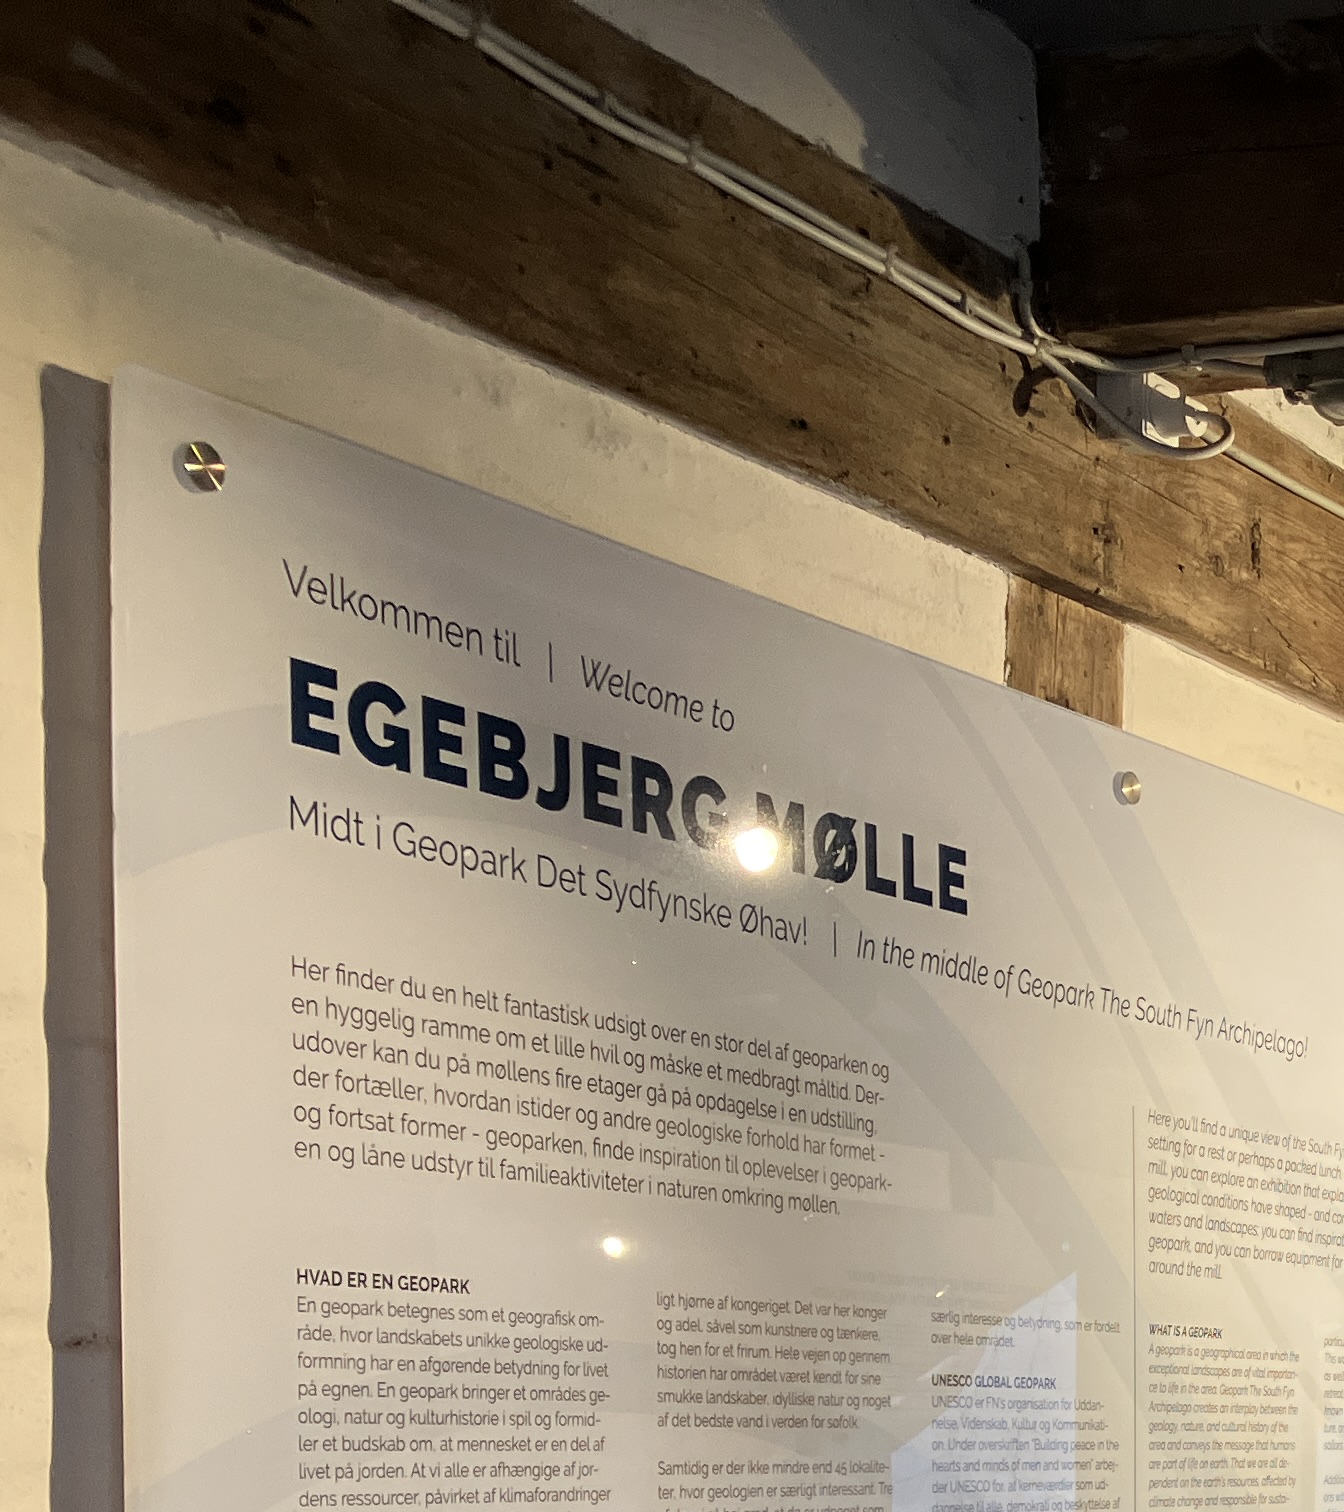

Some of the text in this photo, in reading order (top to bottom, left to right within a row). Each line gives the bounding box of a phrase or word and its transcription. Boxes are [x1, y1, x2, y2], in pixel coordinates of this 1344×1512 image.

[282, 558, 521, 668] Velkommen til
[580, 655, 735, 733] Welcome to
[289, 657, 729, 849] EGEBJERG
[289, 795, 366, 847] Midt
[392, 821, 528, 884] Geopark
[537, 853, 588, 897] Det
[595, 868, 732, 929] Sydfynske
[739, 903, 807, 946] Øhav!
[291, 955, 890, 1084] Her finder du en helt fantastisk udsigt over en stor del af geoparken og
[856, 930, 1308, 1063] In the middle of Geopark The South Fyn Archipelago!
[291, 996, 319, 1017] en
[325, 995, 415, 1039] hyggelig
[421, 1018, 491, 1045] ramme
[495, 1029, 526, 1050] om
[531, 1032, 551, 1055] et
[554, 1033, 586, 1060] lille
[590, 1039, 620, 1066] hvil
[623, 1050, 645, 1075] og
[649, 1052, 703, 1078] måske
[706, 1062, 723, 1082] et
[726, 1067, 801, 1098] medbragt
[855, 1083, 885, 1105] Der-
[292, 1030, 368, 1059] udover
[373, 1039, 409, 1066] kan
[414, 1047, 441, 1071] du
[446, 1053, 471, 1077] på
[476, 1059, 551, 1087] møllens
[555, 1066, 583, 1091] fire
[586, 1074, 643, 1103] etager
[646, 1083, 667, 1108] gå
[671, 1086, 692, 1109] på
[695, 1092, 778, 1120] opdagelse
[788, 1106, 807, 1124] en
[292, 1064, 330, 1089] der
[433, 1082, 511, 1114] hvordan
[516, 1096, 571, 1122] istider
[575, 1107, 598, 1132] og
[602, 1110, 652, 1133] andre
[655, 1117, 743, 1147] geologiske
[746, 1126, 800, 1152] forhold
[803, 1134, 826, 1155] har
[829, 1137, 876, 1162] formet
[293, 1104, 322, 1131] og
[328, 1102, 395, 1134] fortsat
[400, 1111, 467, 1142] former
[592, 1136, 635, 1162] finde
[639, 1148, 721, 1172] inspiration
[725, 1154, 739, 1175] til
[742, 1158, 819, 1184] oplevelser
[830, 1171, 892, 1193] geopark-
[293, 1140, 321, 1160] en
[327, 1144, 355, 1170] og
[361, 1142, 406, 1170] låne
[411, 1150, 474, 1181] udstyr
[477, 1157, 496, 1179] til
[499, 1158, 645, 1194] familieaktiviteter
[656, 1179, 718, 1202] naturen
[721, 1186, 784, 1215] omkring
[296, 1268, 470, 1294] HVAD ER EN GEOPARK
[297, 1294, 604, 1329] En geopark betegnes som et geografisk om-
[1149, 1324, 1173, 1336] WHAT
[1188, 1326, 1223, 1340] GEOPARK
[931, 1374, 1057, 1390] UNESCO GLOBAL GEOPARK
